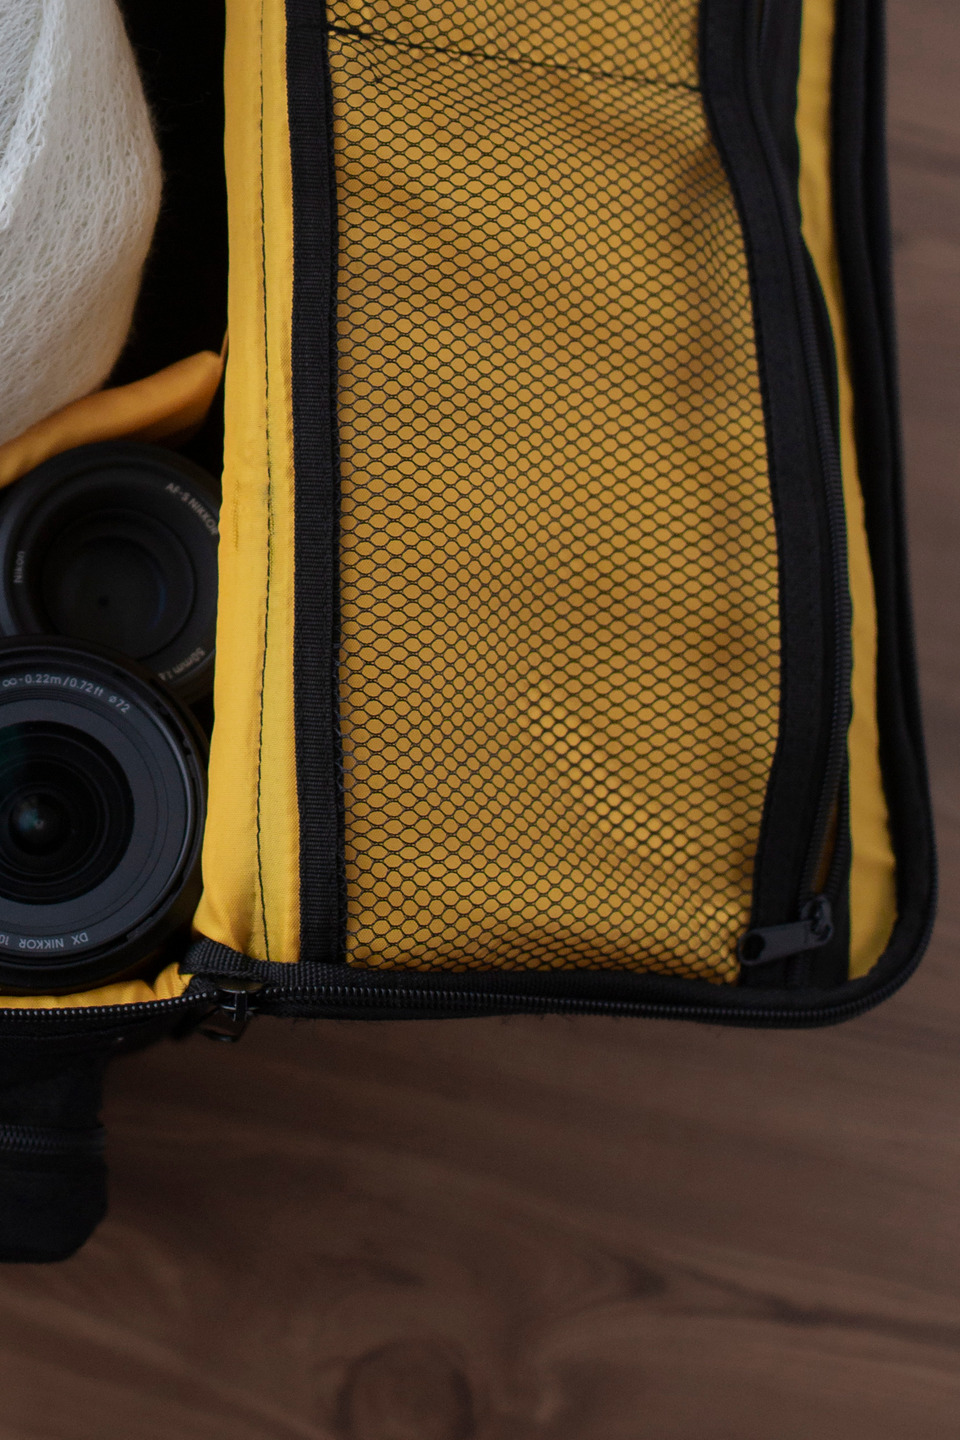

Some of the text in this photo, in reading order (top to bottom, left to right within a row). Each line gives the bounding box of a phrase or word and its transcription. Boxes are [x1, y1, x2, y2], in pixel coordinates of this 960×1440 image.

[165, 482, 190, 503] AF-S
[13, 550, 26, 584] Nikon
[18, 937, 65, 950] NIKKOR
[72, 931, 89, 945] DX
